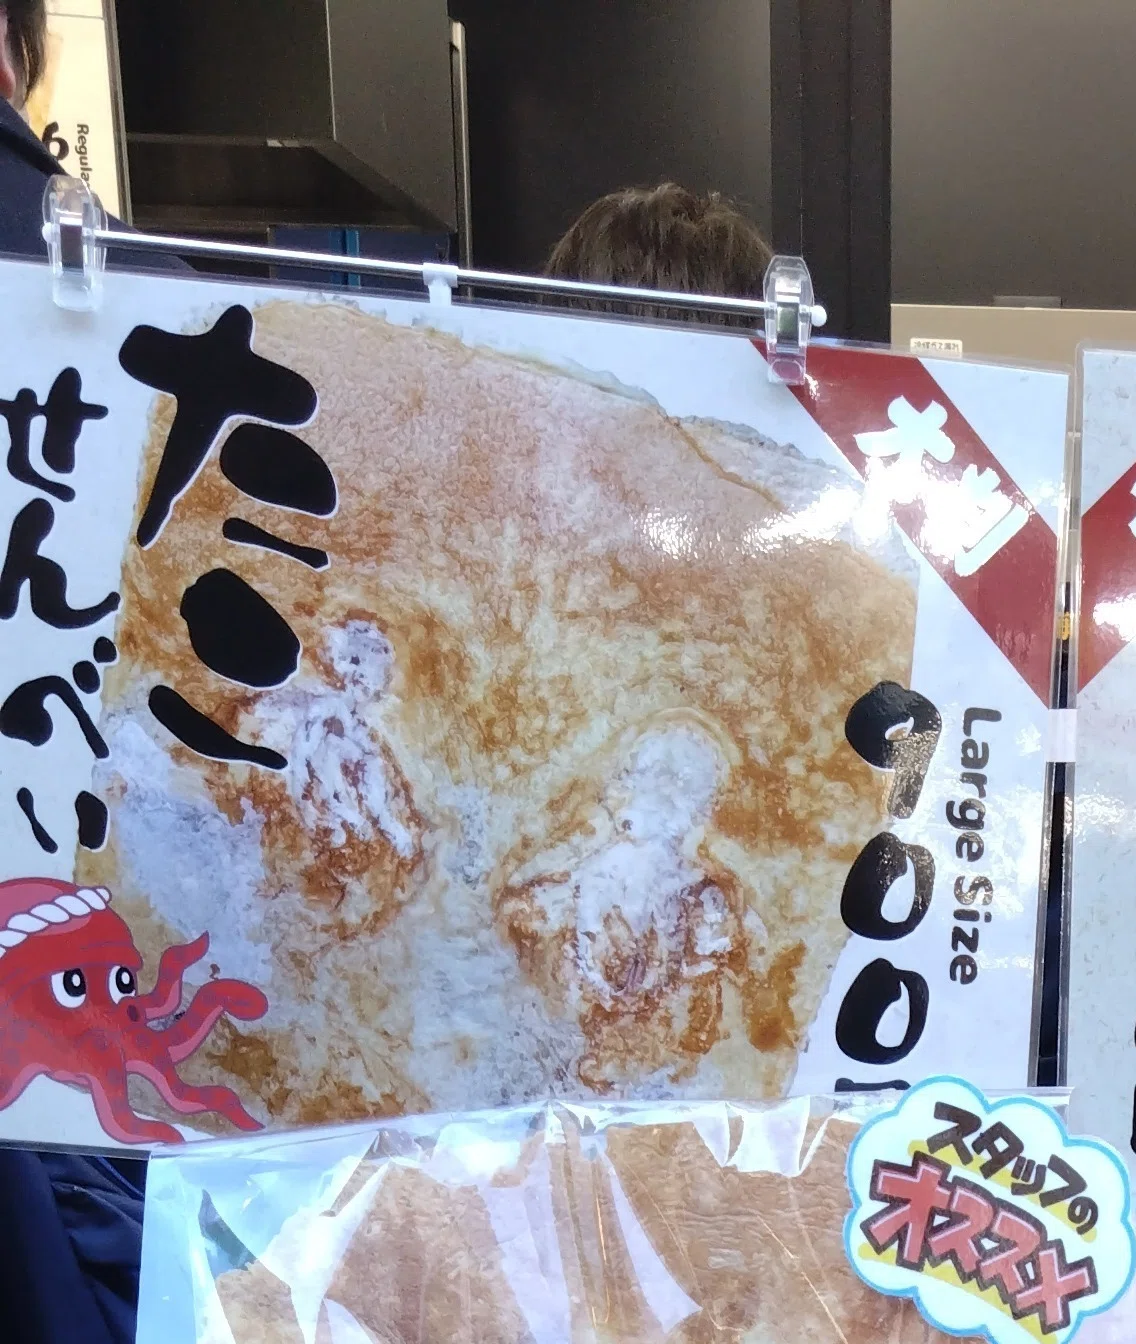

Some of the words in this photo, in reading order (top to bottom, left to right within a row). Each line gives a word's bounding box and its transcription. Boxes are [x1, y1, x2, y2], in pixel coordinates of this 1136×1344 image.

[75, 123, 93, 188] Regula
[0, 366, 120, 853] せんべい
[119, 304, 338, 770] たこ
[946, 707, 1003, 862] Large
[835, 680, 943, 1092] 900
[949, 874, 994, 985] Size
[860, 1150, 1100, 1335] オススメ
[925, 1101, 1100, 1234] スタッフの
